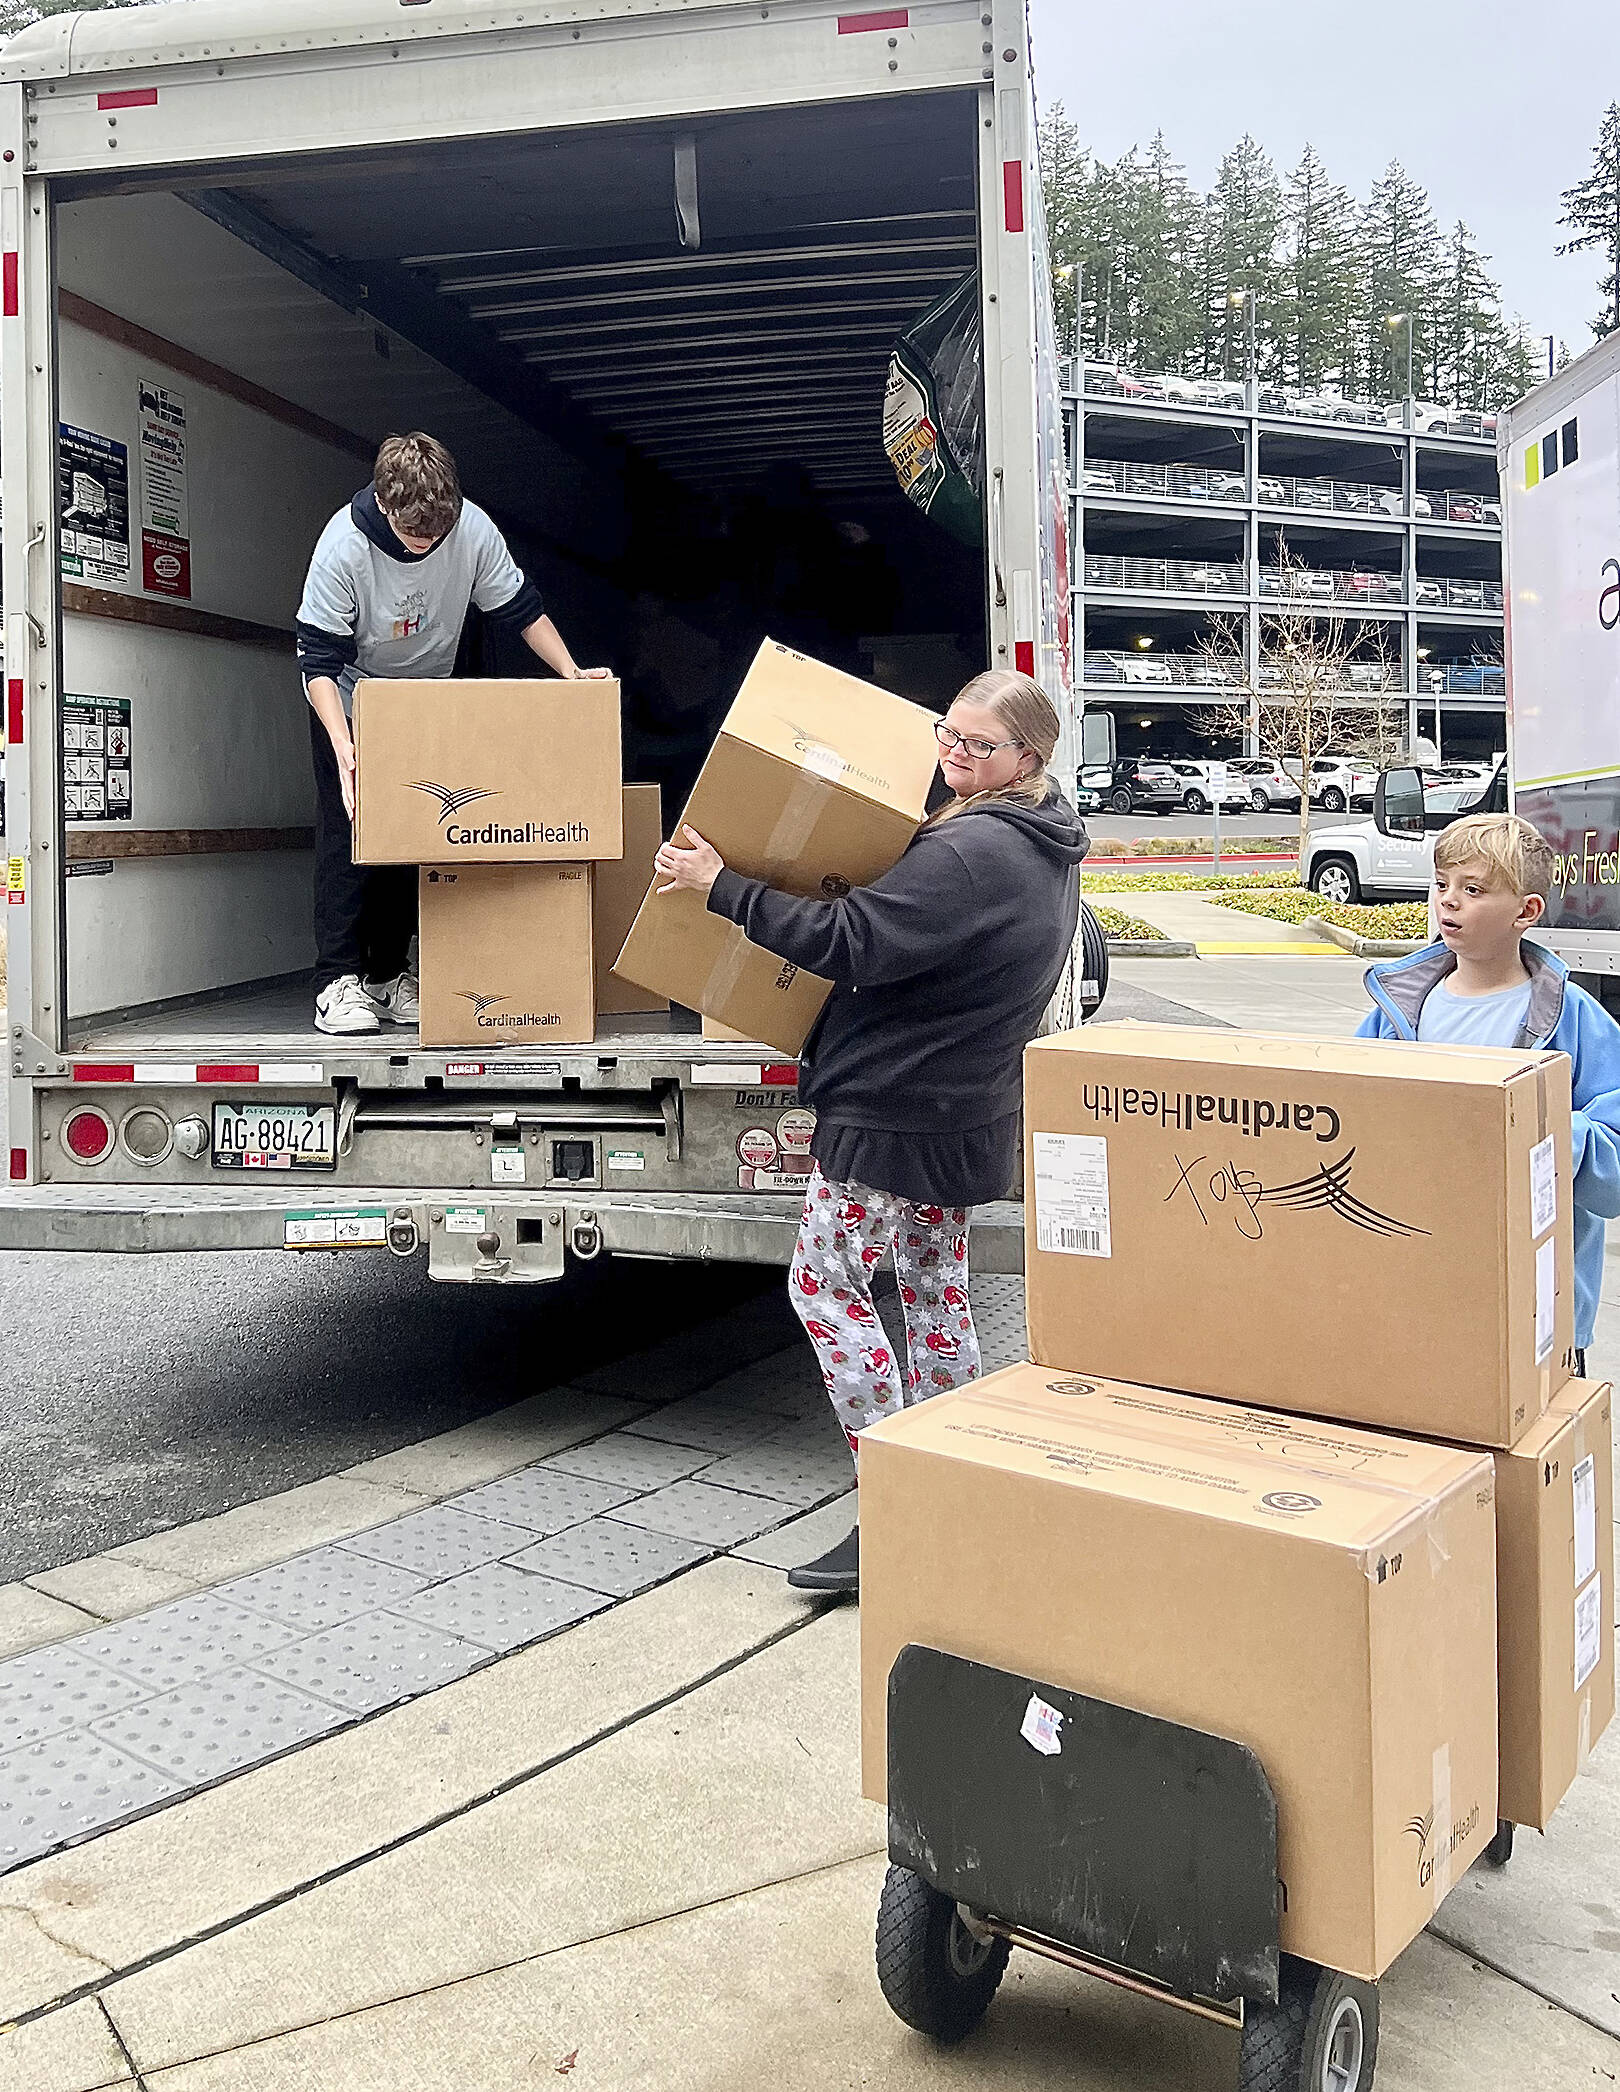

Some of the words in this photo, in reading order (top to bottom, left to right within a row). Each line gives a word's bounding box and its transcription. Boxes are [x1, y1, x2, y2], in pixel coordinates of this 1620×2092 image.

[895, 440, 918, 466] DEAL
[446, 821, 590, 845] CardinalHealth
[1377, 838, 1428, 856] Security
[1552, 853, 1579, 900] ays
[1582, 830, 1620, 886] Fres
[477, 1012, 562, 1028] CardinalHealth
[735, 1090, 777, 1106] Don't
[244, 1107, 307, 1116] ARIZONA
[1082, 1084, 1341, 1143] CardinalHealth
[1419, 1800, 1480, 1888] CarlHealth
